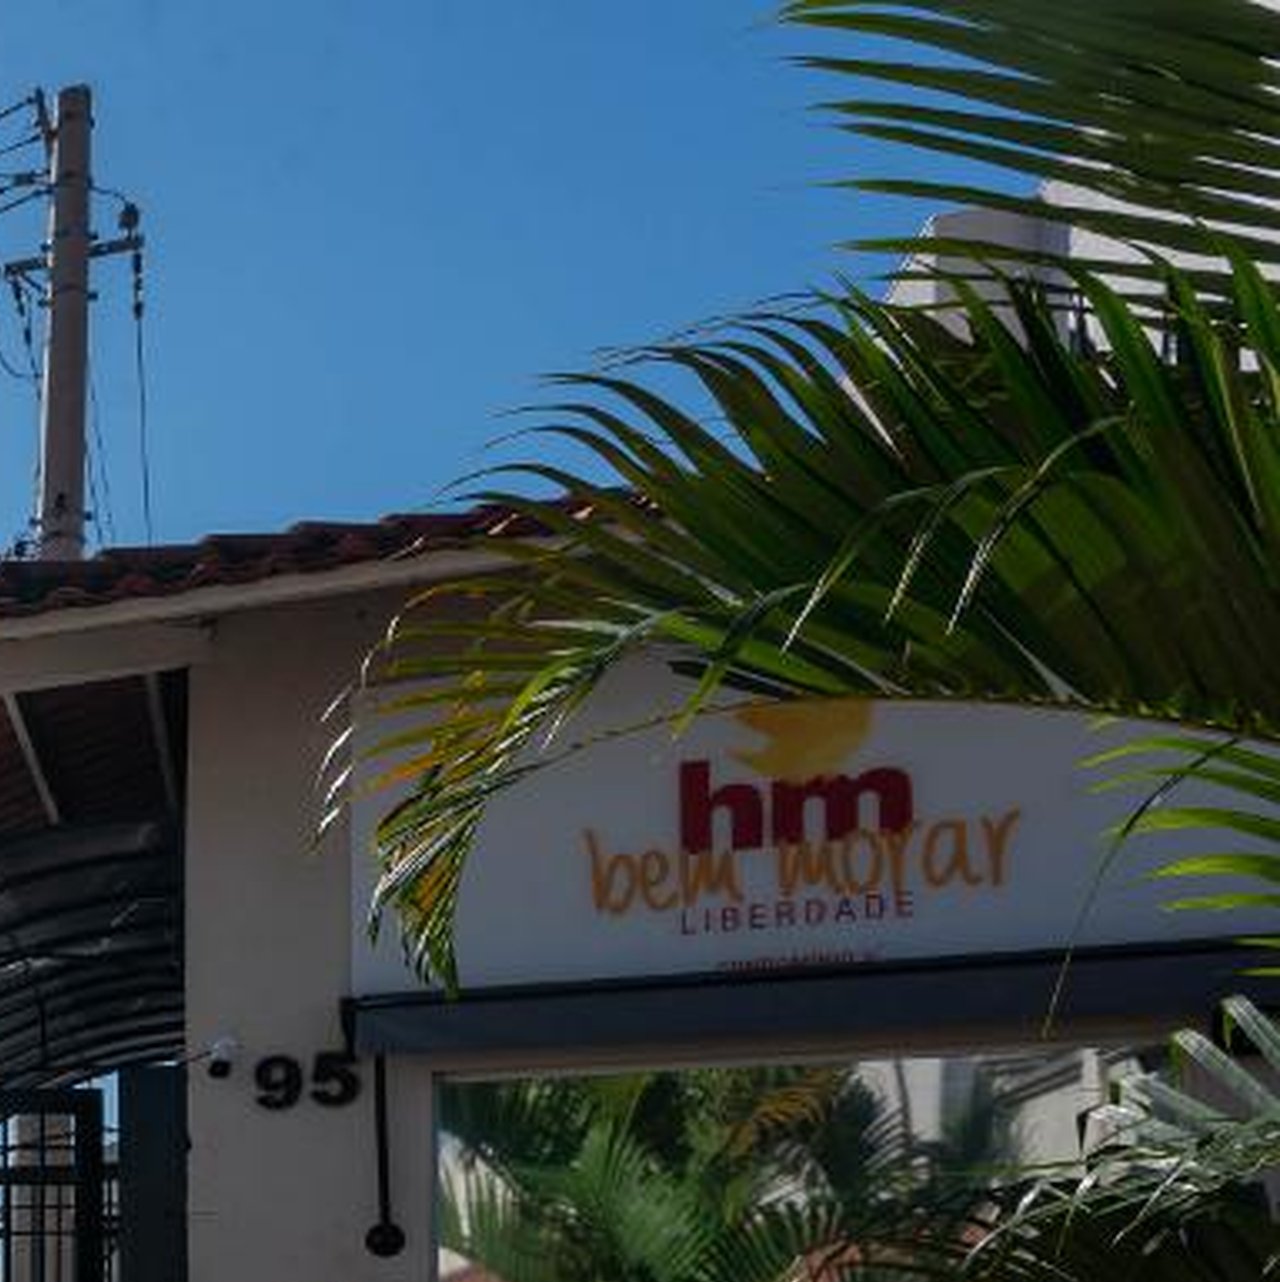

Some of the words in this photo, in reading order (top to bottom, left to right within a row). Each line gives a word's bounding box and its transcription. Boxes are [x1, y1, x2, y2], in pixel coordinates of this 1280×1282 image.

[679, 759, 913, 856] hm
[584, 826, 744, 917] bem
[778, 803, 1021, 904] morar
[680, 890, 915, 936] LIBERDADE
[253, 1053, 362, 1110] 95
